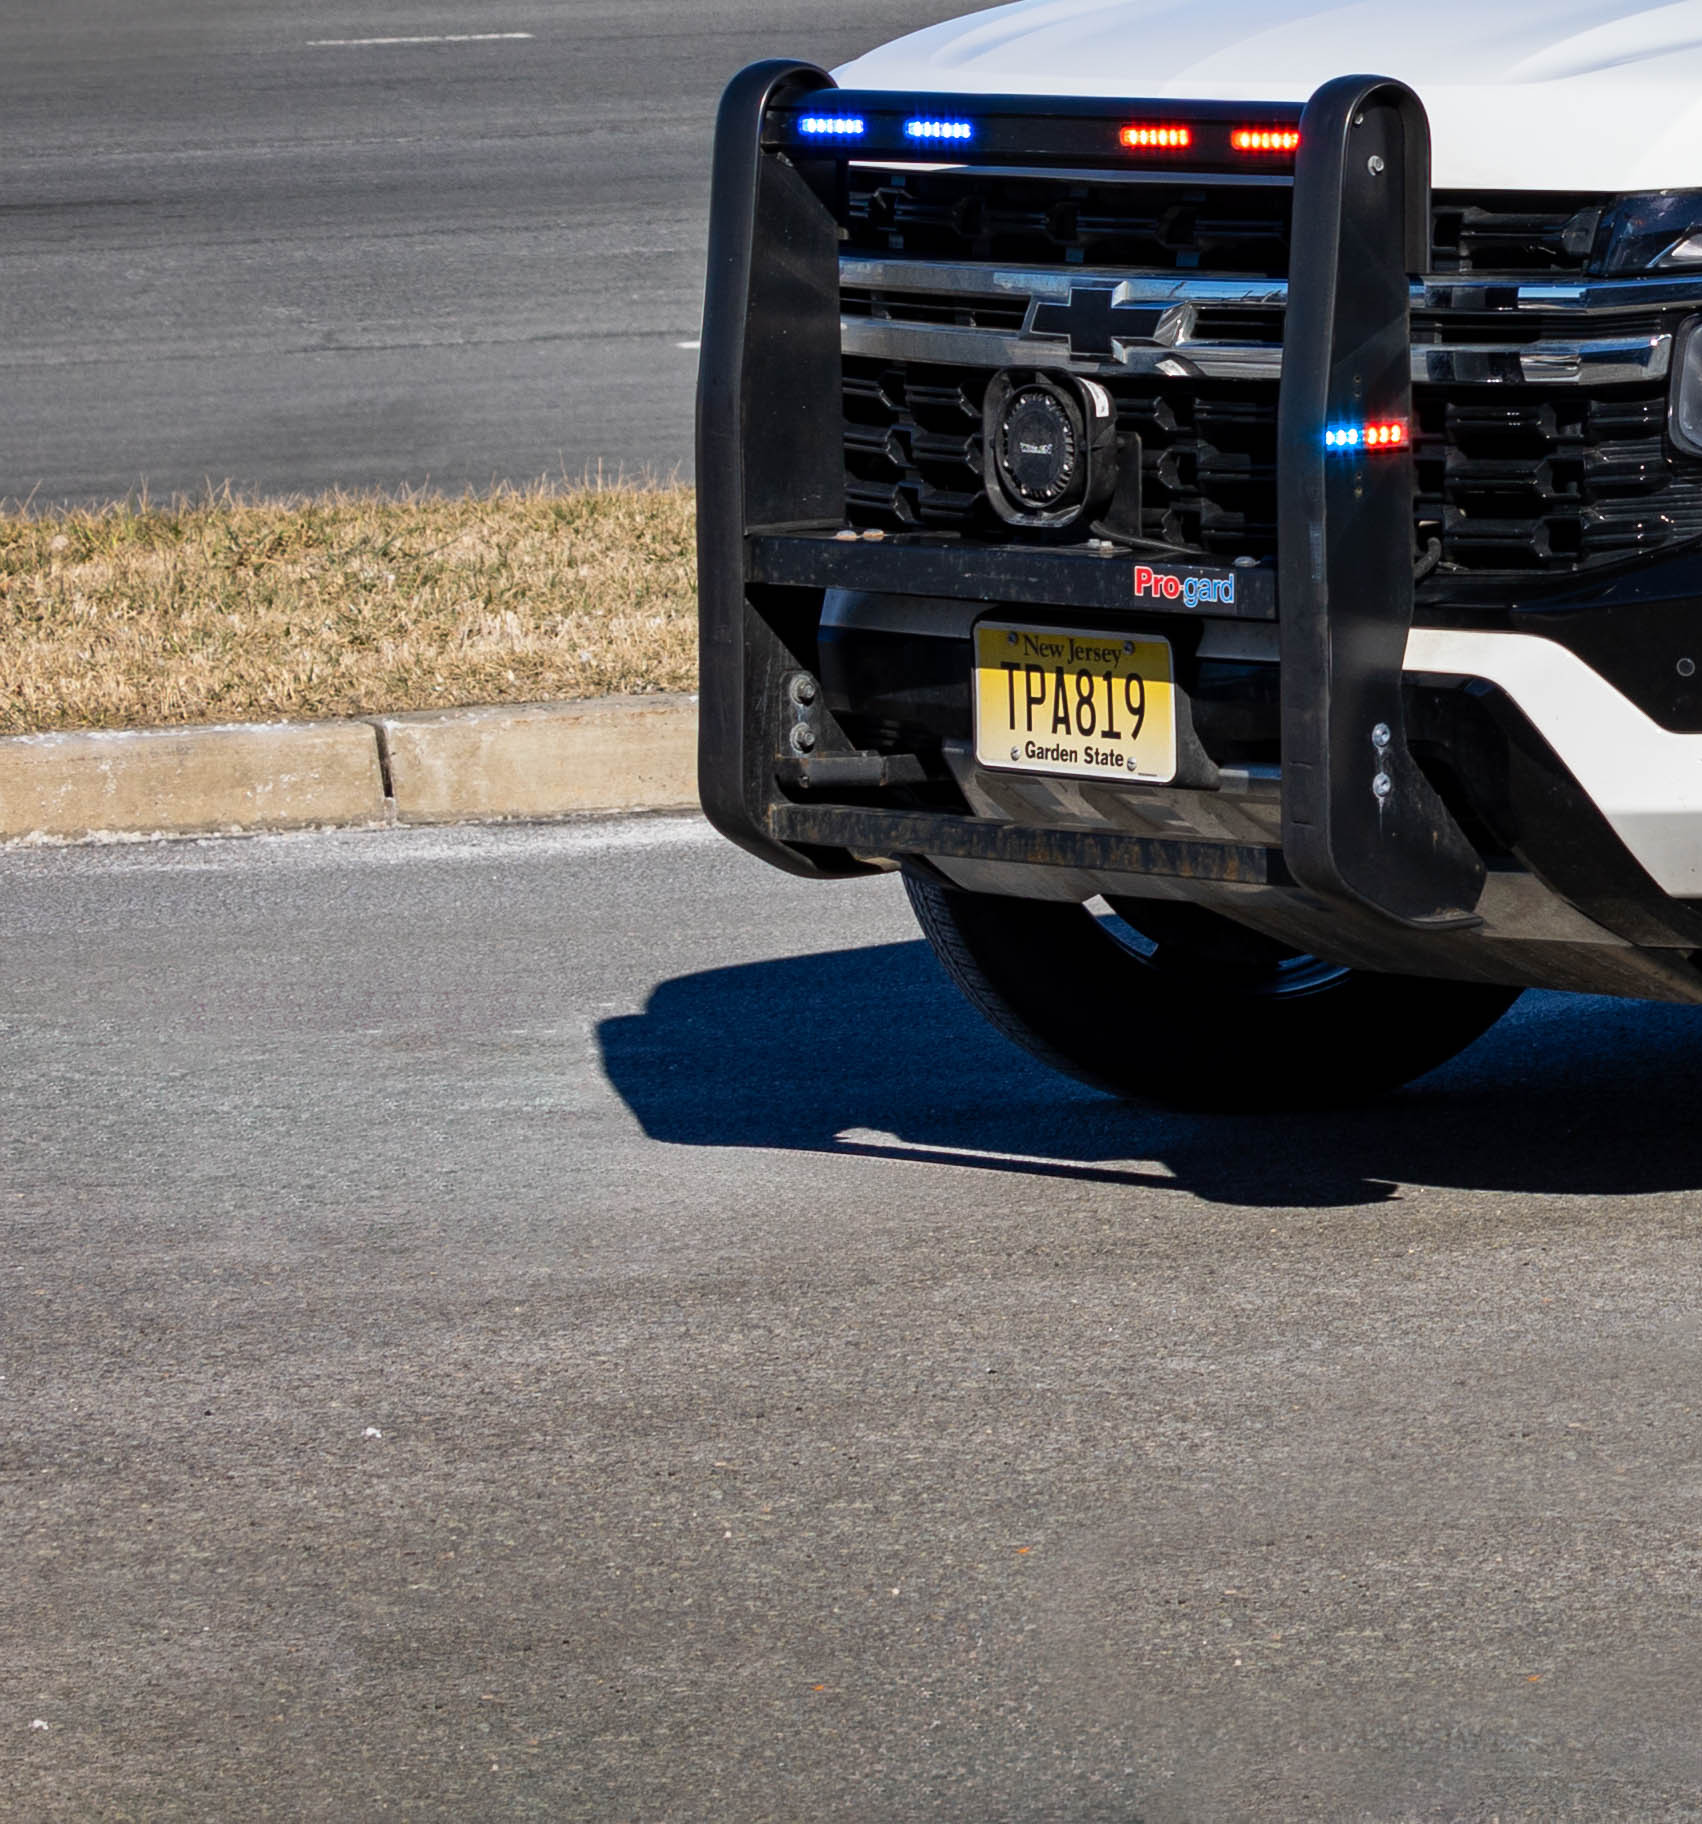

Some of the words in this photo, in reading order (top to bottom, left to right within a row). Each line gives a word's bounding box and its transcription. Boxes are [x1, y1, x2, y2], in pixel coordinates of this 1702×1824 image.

[1134, 565, 1235, 608] Pro-gard
[1023, 634, 1064, 657] New
[1067, 638, 1122, 668] Jersey
[1001, 661, 1146, 741] TPA819
[1025, 740, 1078, 764] Garden
[1084, 745, 1124, 767] State
